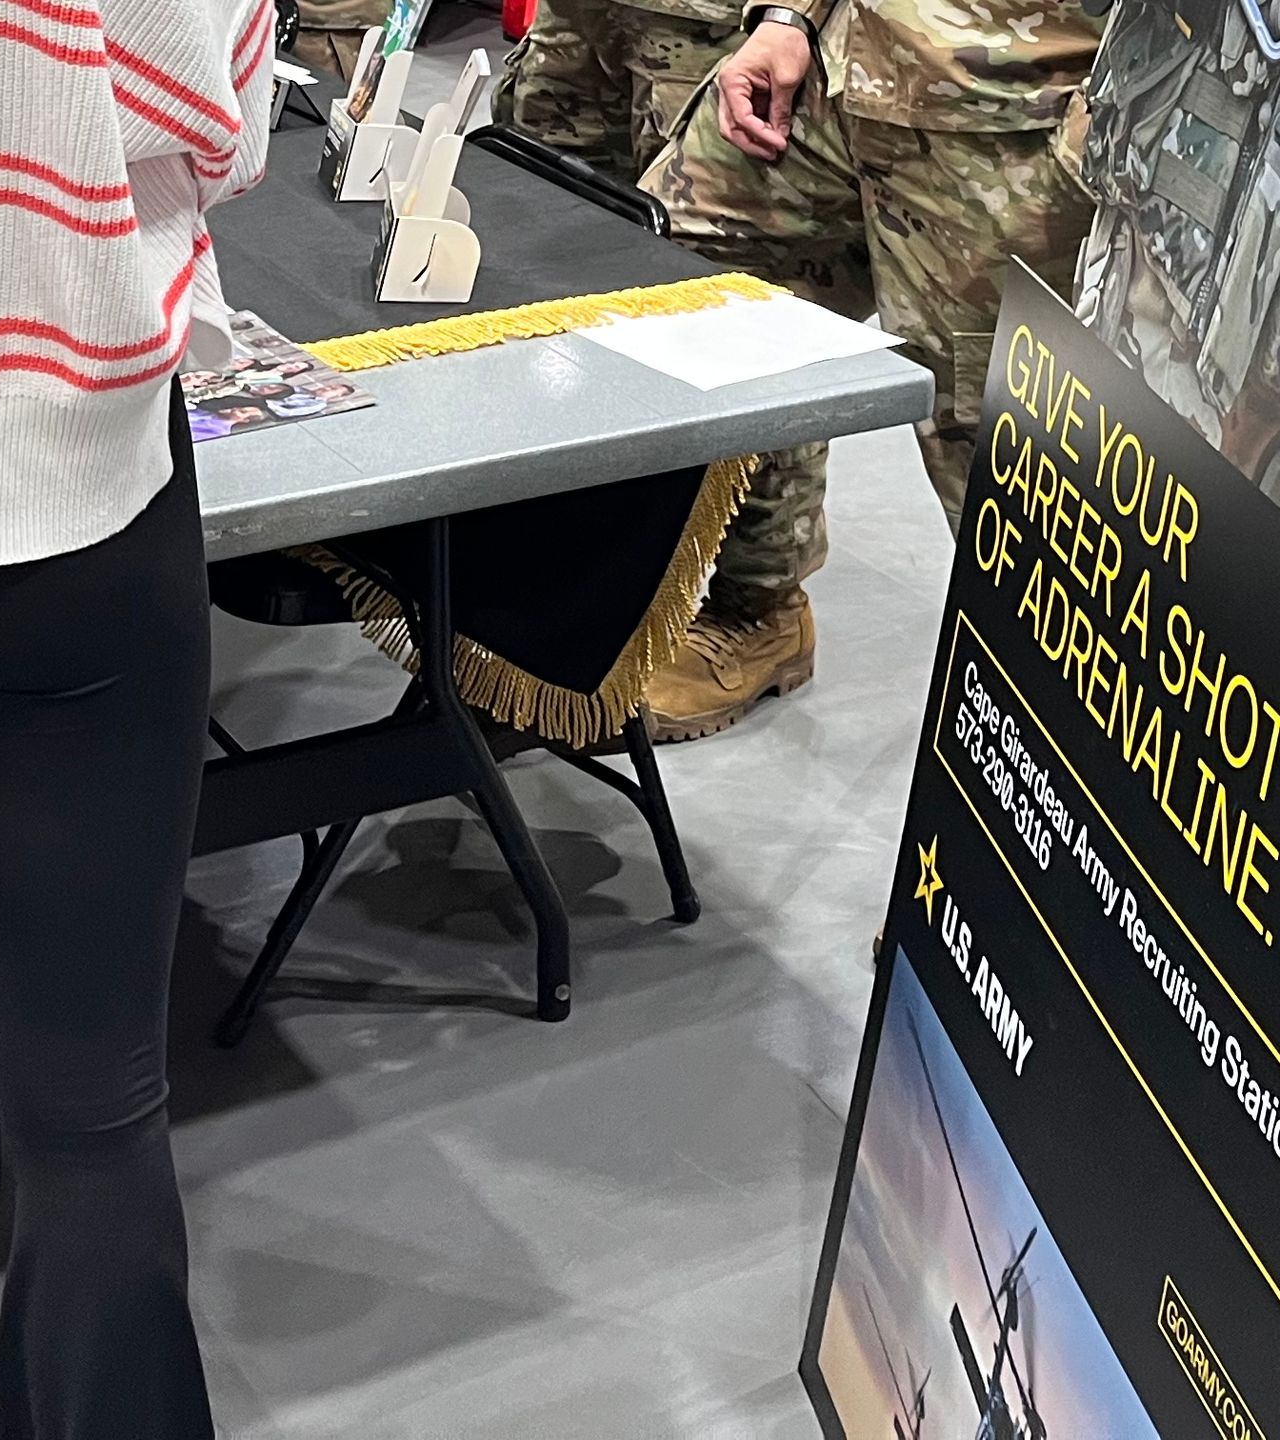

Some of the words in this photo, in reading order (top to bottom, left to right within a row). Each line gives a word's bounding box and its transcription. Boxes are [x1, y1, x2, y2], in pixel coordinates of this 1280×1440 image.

[990, 411, 1123, 618] CAREER
[1120, 568, 1151, 660] A
[1006, 324, 1091, 465] GIVE
[1094, 403, 1199, 583] YOUR
[955, 702, 1053, 871] 573-290-3116
[975, 497, 1023, 588] OF
[1017, 557, 1280, 947] ADRENALINE.
[941, 893, 972, 984] U.S.
[971, 955, 1034, 1077] ARMY
[964, 661, 1000, 735] Cape
[1000, 714, 1074, 847] Girardeau
[1072, 823, 1120, 917] Army
[1119, 887, 1221, 1068] Recruiting
[1166, 1300, 1251, 1440] GOARMY.CO
